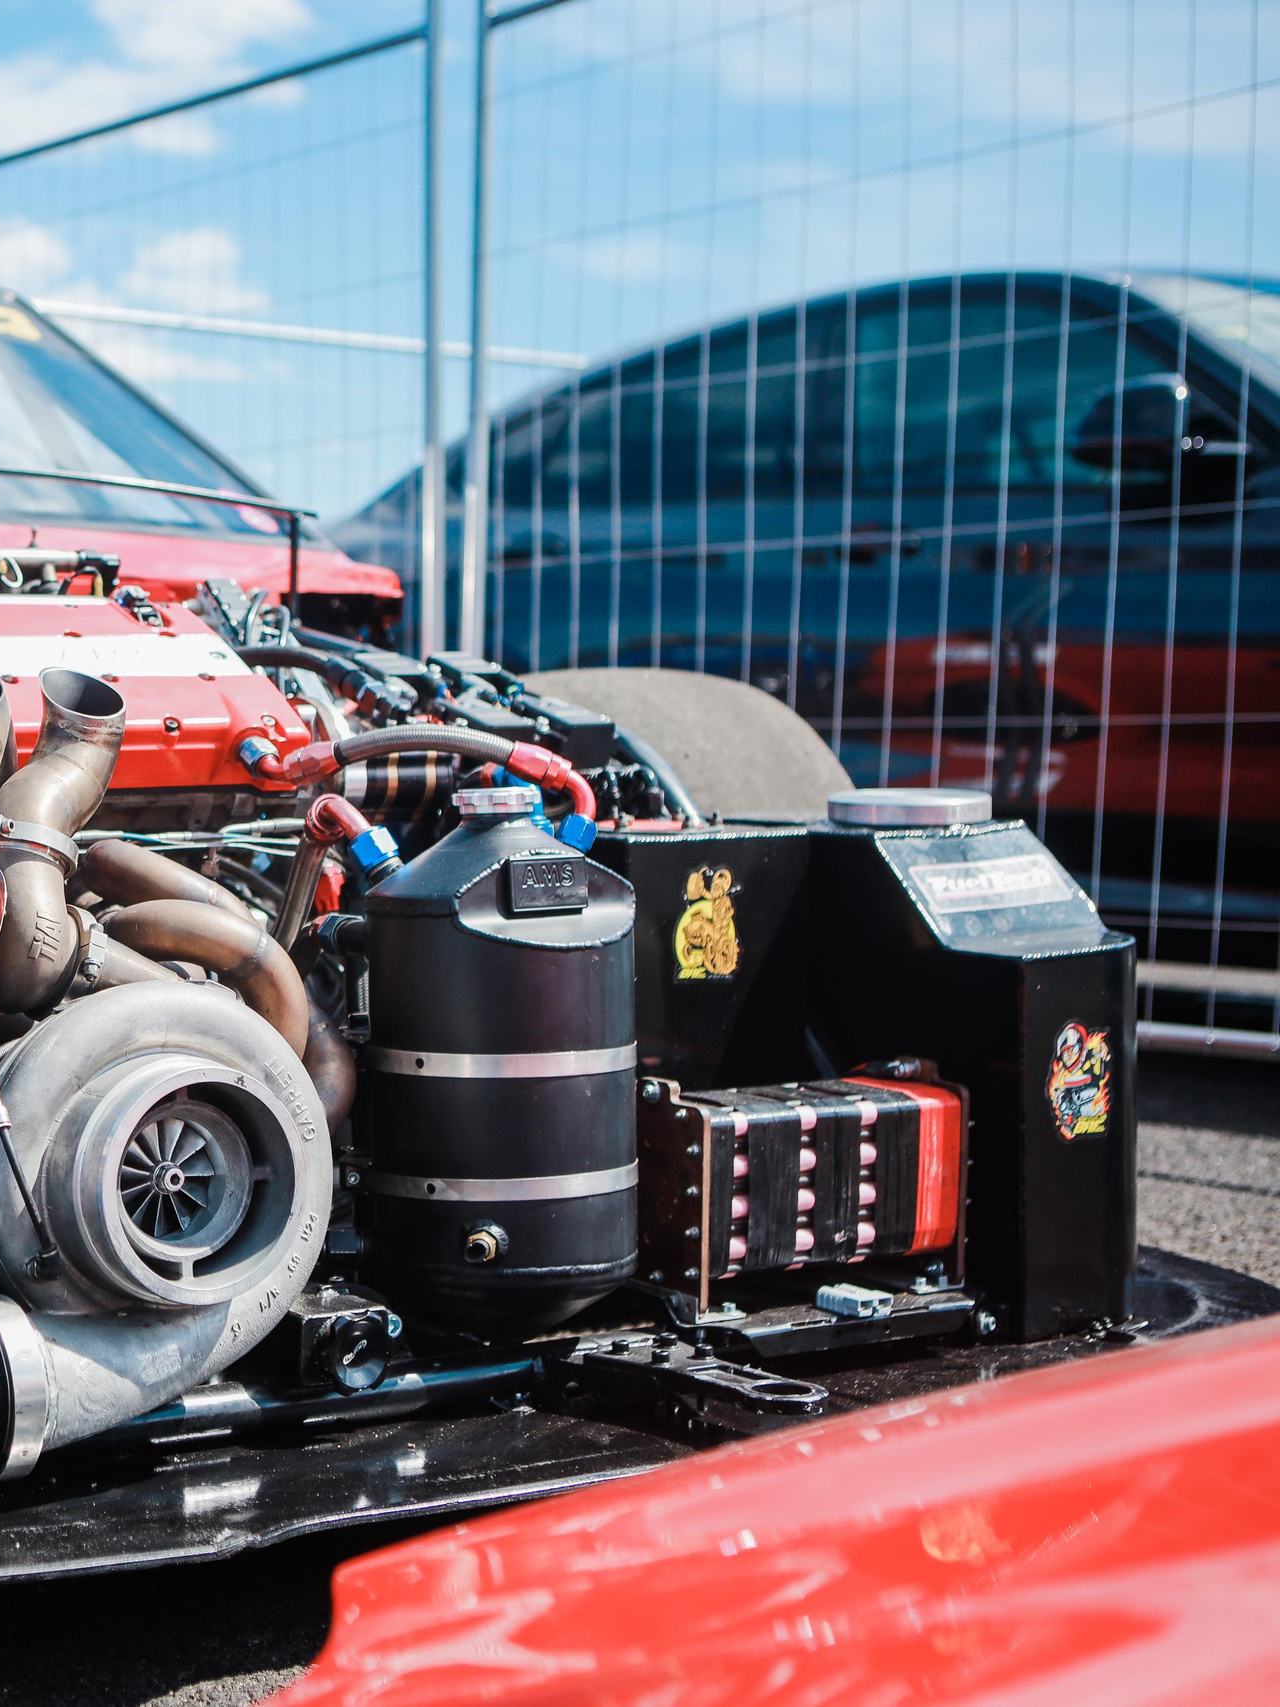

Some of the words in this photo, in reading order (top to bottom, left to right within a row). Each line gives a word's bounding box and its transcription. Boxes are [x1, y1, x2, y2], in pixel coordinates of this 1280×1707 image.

[522, 863, 574, 888] AMS
[264, 1055, 316, 1142] GARRETT
[259, 1287, 280, 1313] A/R
